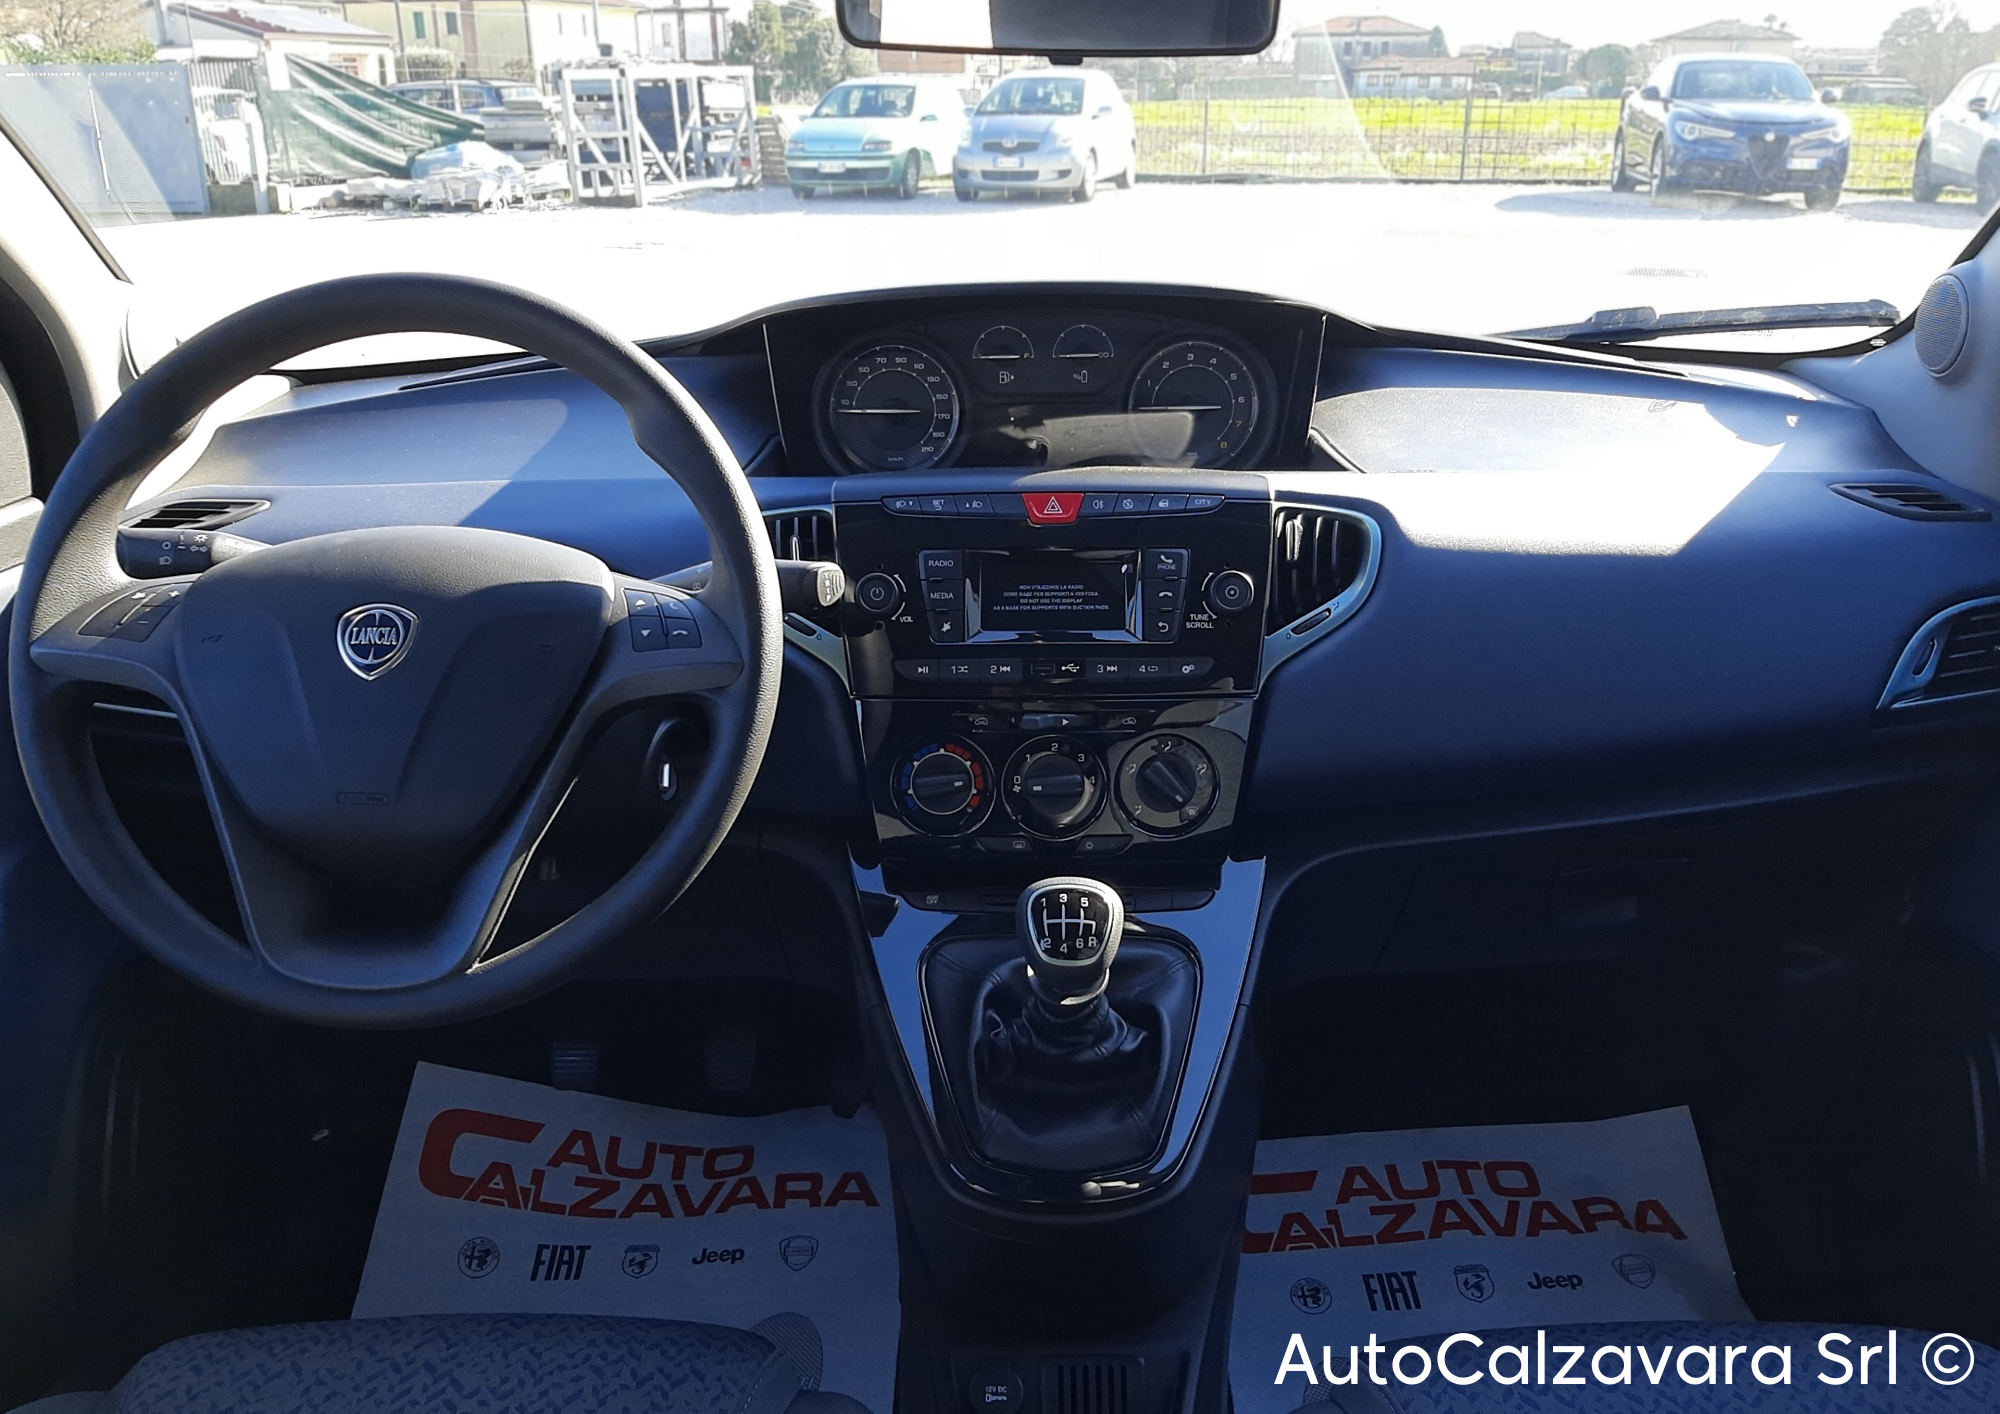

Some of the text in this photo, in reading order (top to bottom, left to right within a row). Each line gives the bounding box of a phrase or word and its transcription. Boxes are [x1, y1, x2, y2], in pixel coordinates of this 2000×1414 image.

[1162, 361, 1170, 369] 2
[899, 615, 914, 623] VOL
[1189, 613, 1210, 621] TUNE
[1185, 621, 1214, 629] SCROLL
[350, 627, 398, 645] LANCIA
[950, 665, 957, 674] 1
[990, 665, 997, 674] 2
[1096, 664, 1104, 673] 3
[1138, 664, 1147, 673] 4
[1051, 742, 1059, 752] 2
[1025, 753, 1030, 762] 1
[1077, 753, 1085, 762] 3
[1013, 775, 1021, 784] 0
[1088, 775, 1095, 784] 4
[1040, 897, 1047, 907] 1
[1059, 893, 1068, 903] 3
[1080, 897, 1089, 907] 5
[1043, 938, 1052, 949] 2
[1075, 938, 1084, 949] 6
[1088, 936, 1097, 948] R
[1059, 943, 1068, 954] 4
[546, 1129, 756, 1181] AUTO
[419, 1108, 881, 1219] CALZAVARA
[1335, 1160, 1542, 1205] AUTO
[692, 1247, 745, 1266] Jeep
[530, 1243, 592, 1282] FIAT
[1527, 1272, 1584, 1290] Jeep
[1361, 1270, 1423, 1312] FIAT
